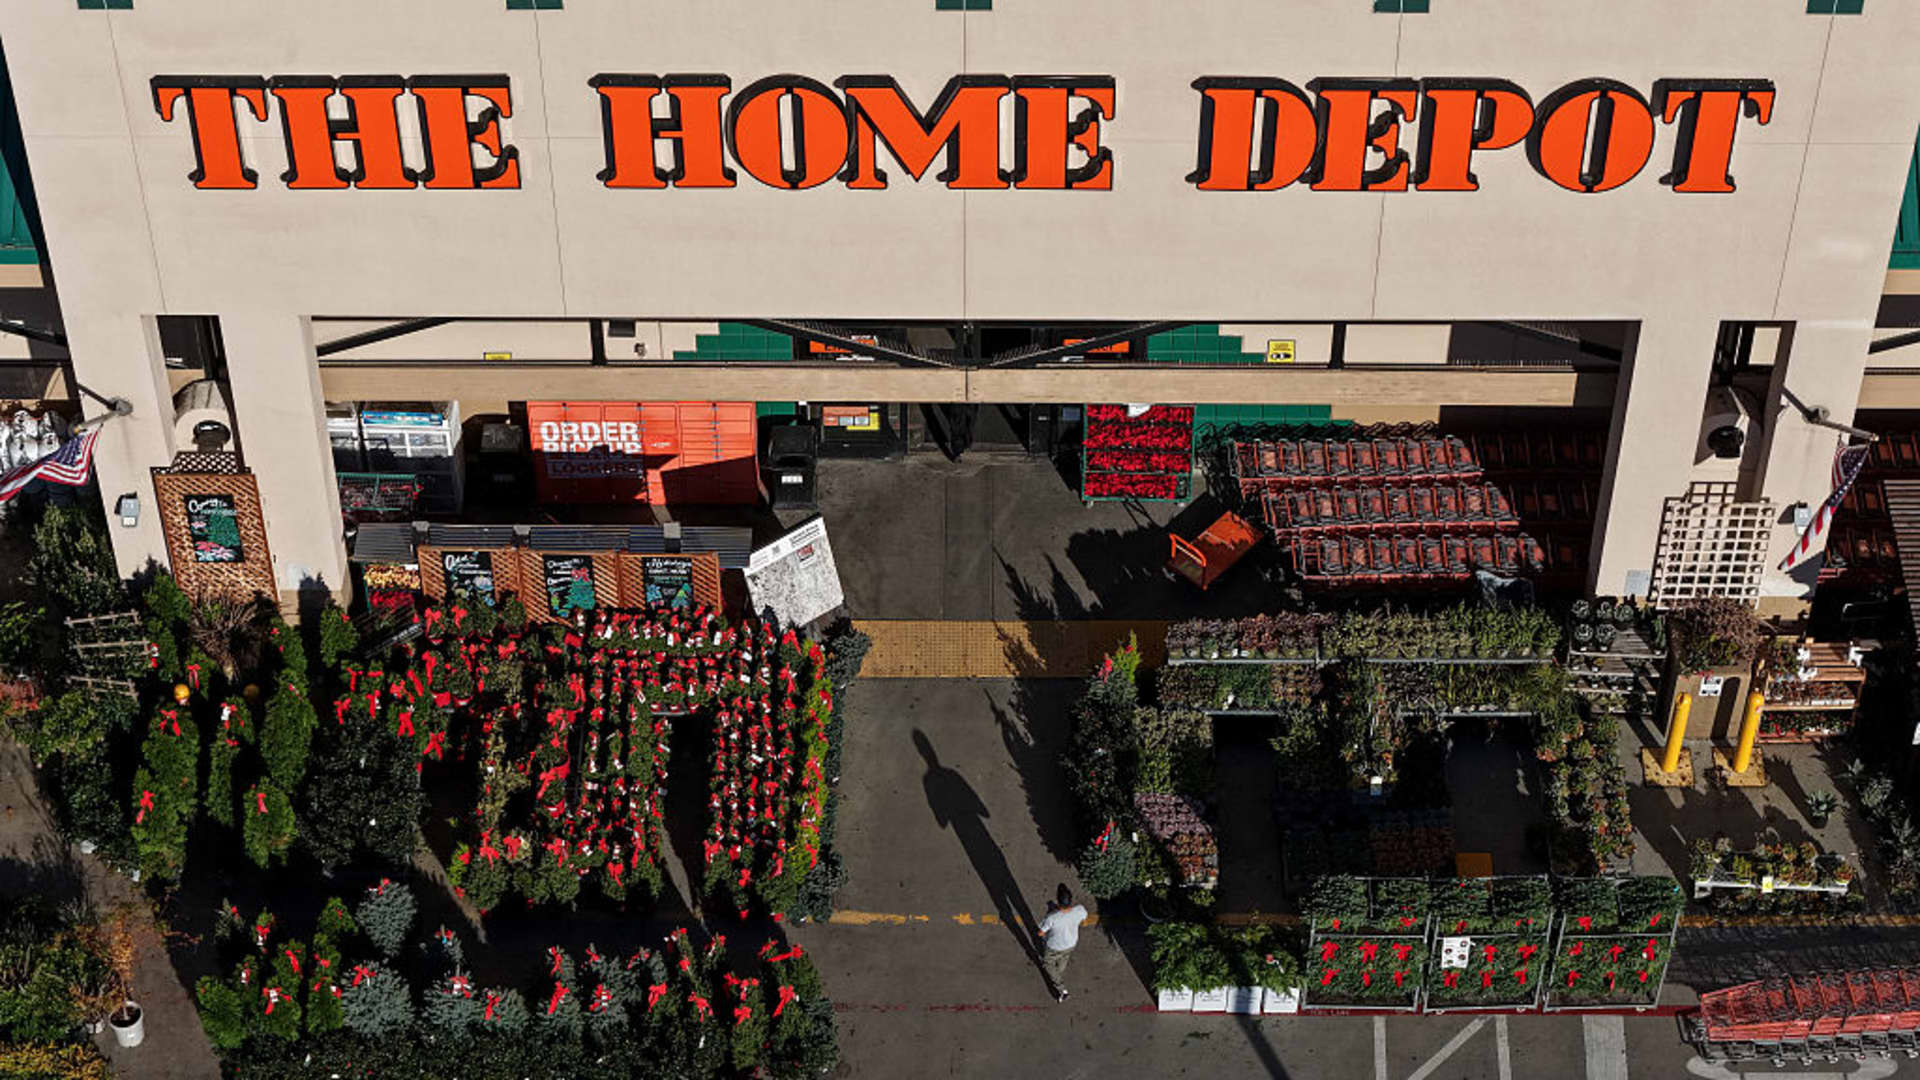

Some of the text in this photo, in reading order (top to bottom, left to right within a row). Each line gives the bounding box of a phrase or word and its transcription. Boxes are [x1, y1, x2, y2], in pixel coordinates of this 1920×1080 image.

[151, 74, 1775, 193] THE HOME DEPOT
[540, 421, 641, 441] ORDER
[550, 462, 641, 474] LOCKERS
